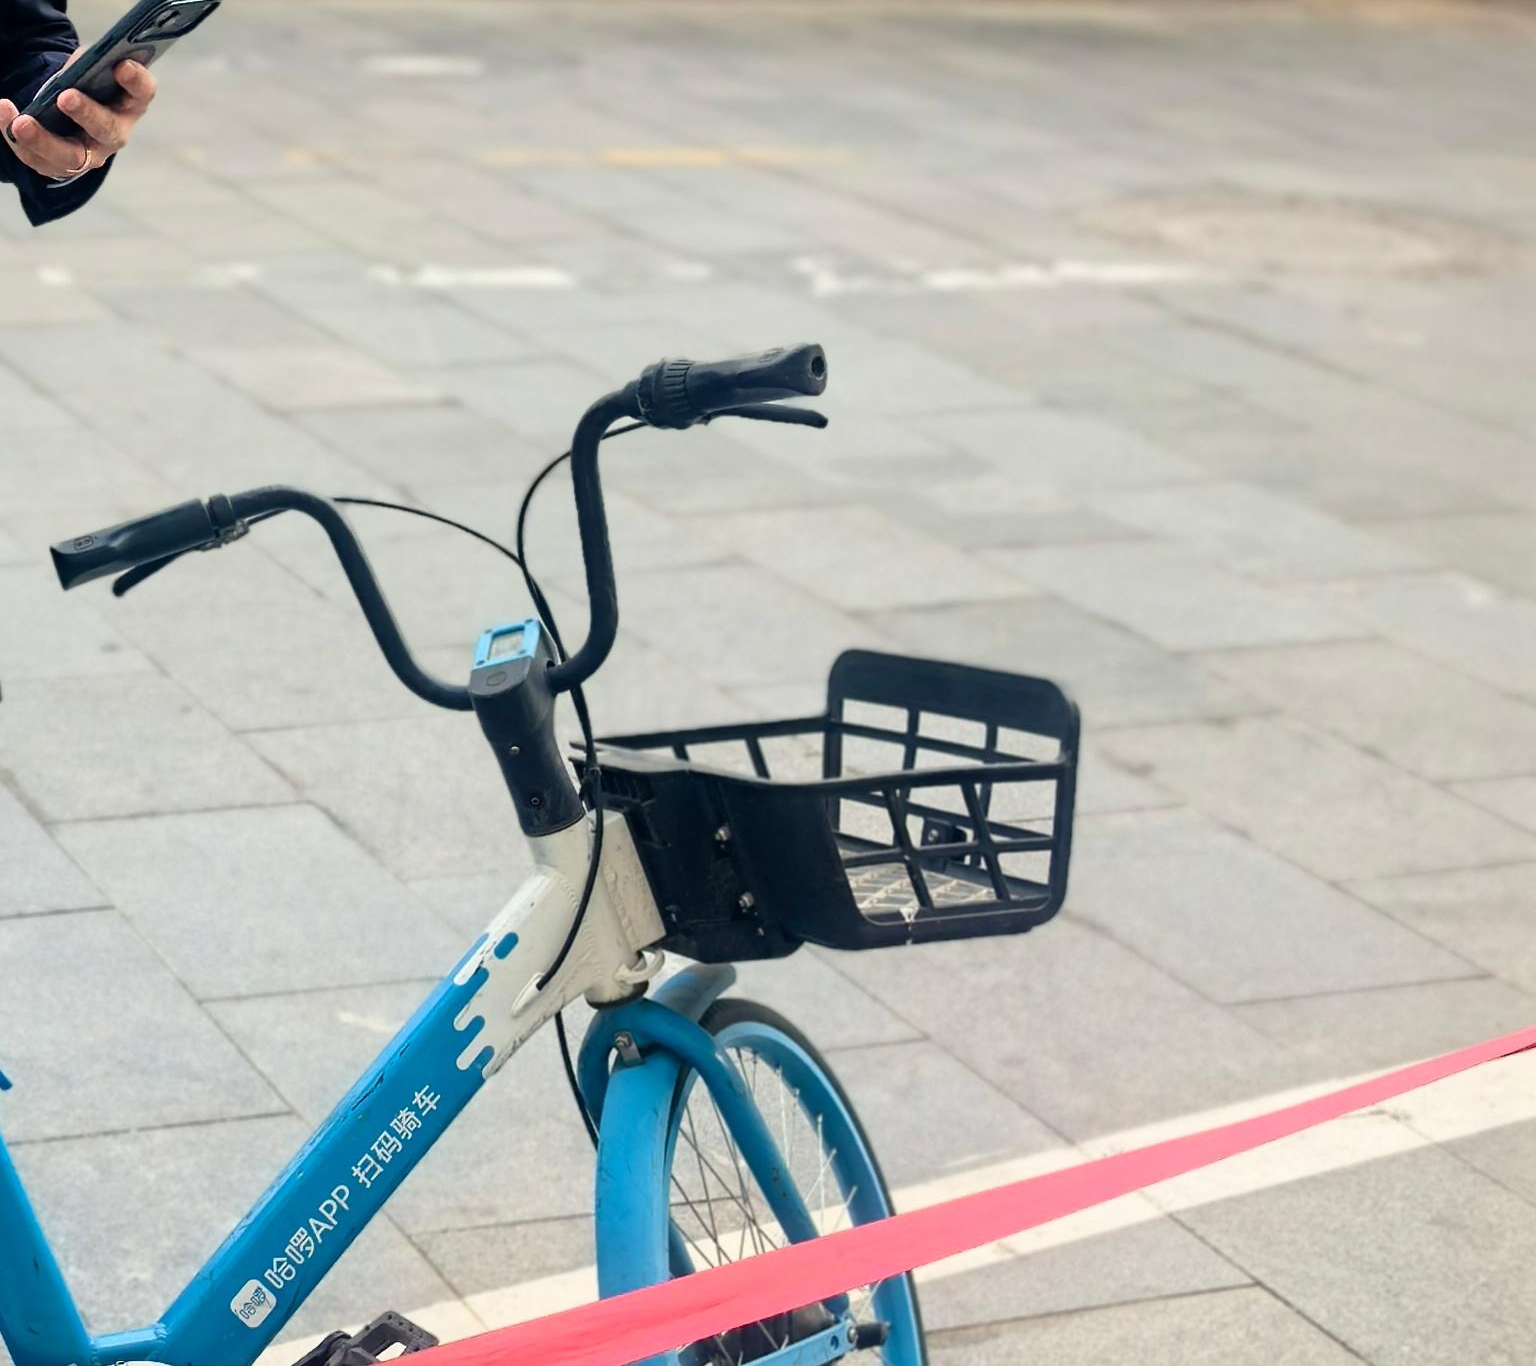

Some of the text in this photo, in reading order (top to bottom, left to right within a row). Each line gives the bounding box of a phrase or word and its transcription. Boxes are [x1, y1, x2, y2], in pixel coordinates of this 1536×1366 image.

[264, 1085, 441, 1289] 哈啰APP 扫码骑车
